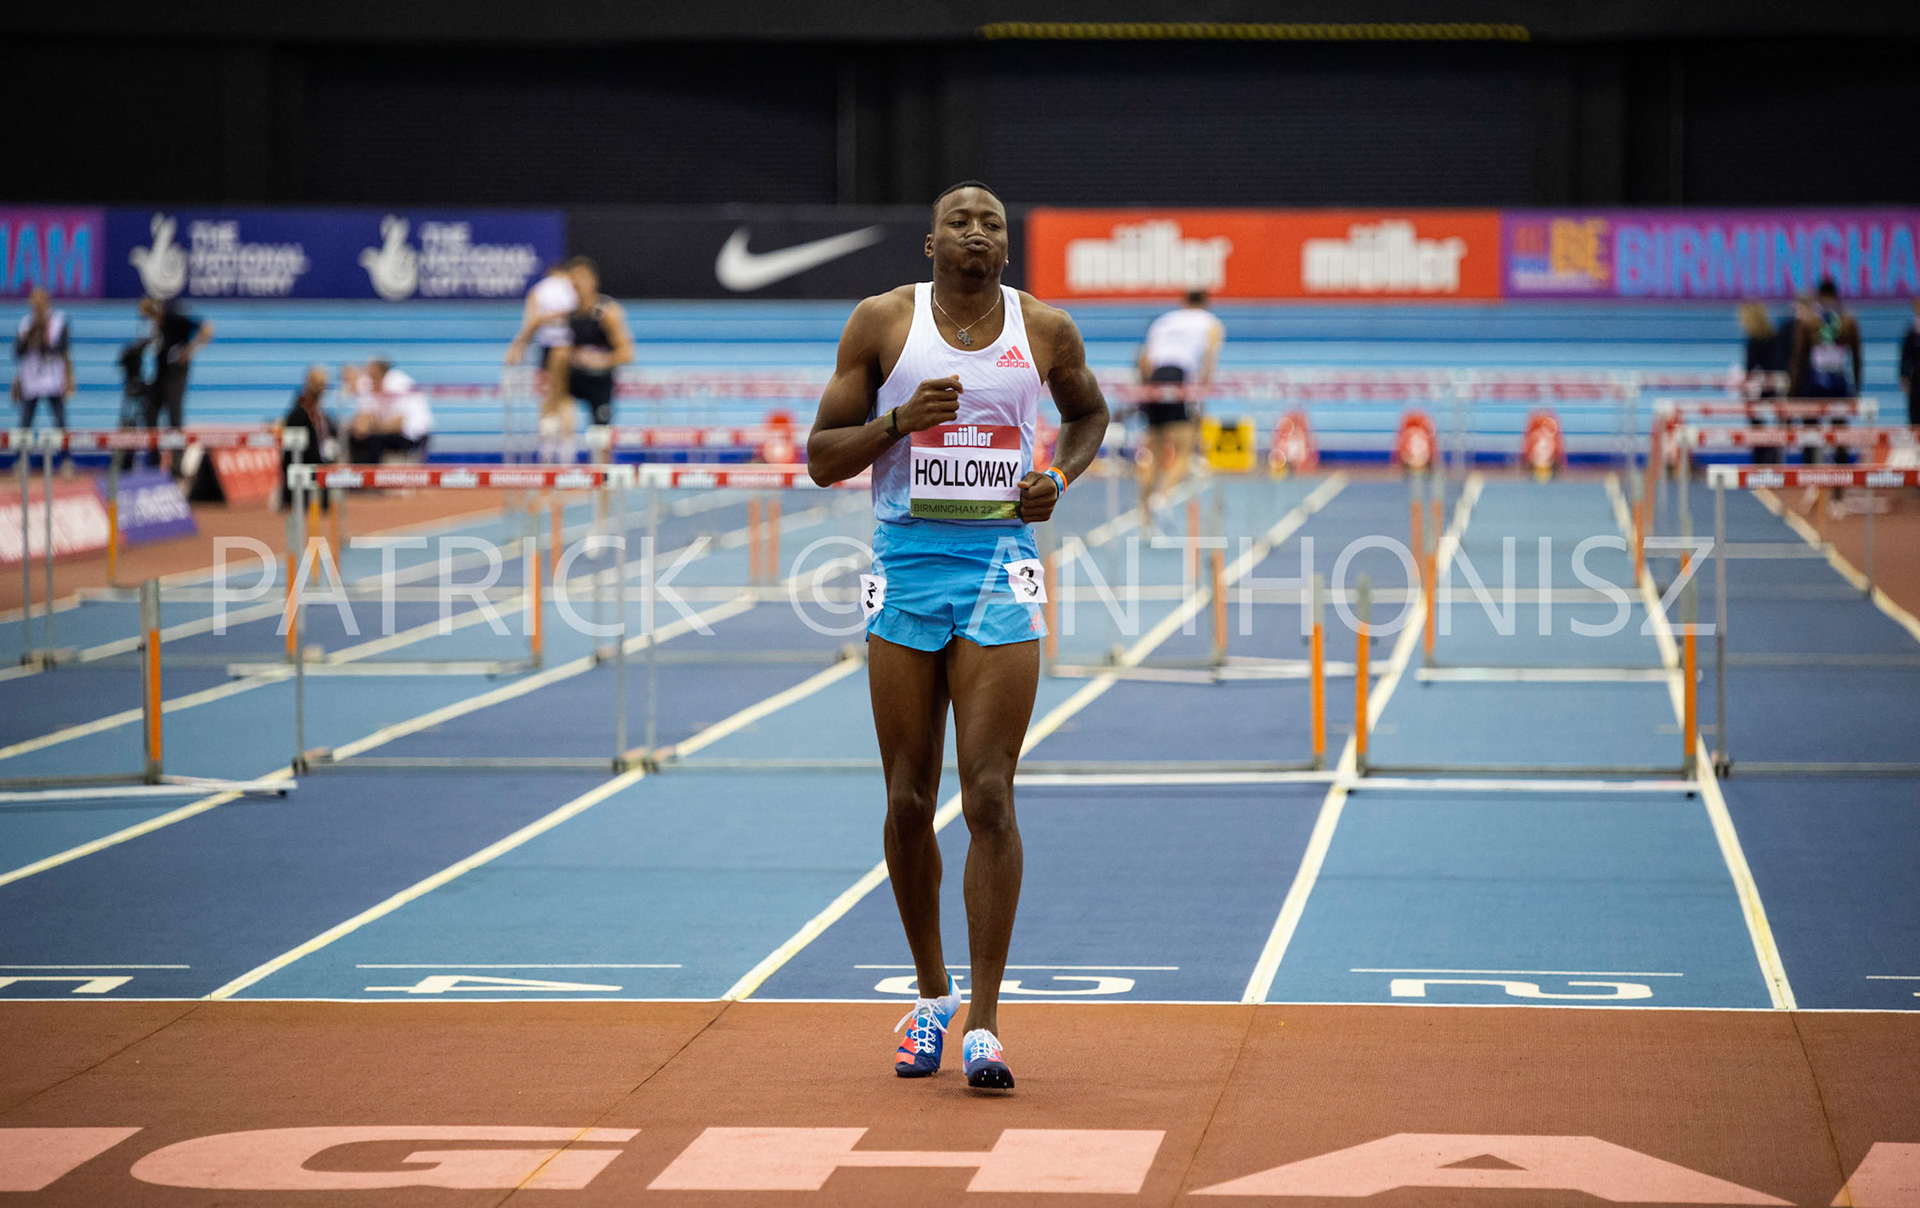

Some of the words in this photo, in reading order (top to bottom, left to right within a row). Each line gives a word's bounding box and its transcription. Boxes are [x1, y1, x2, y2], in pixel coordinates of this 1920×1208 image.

[996, 360, 1030, 369] adidas
[943, 426, 993, 447] müller
[915, 459, 1018, 487] HOLLOWAY
[914, 503, 978, 514] BIRMINGHAM
[981, 506, 993, 514] 22
[1019, 566, 1038, 597] 3
